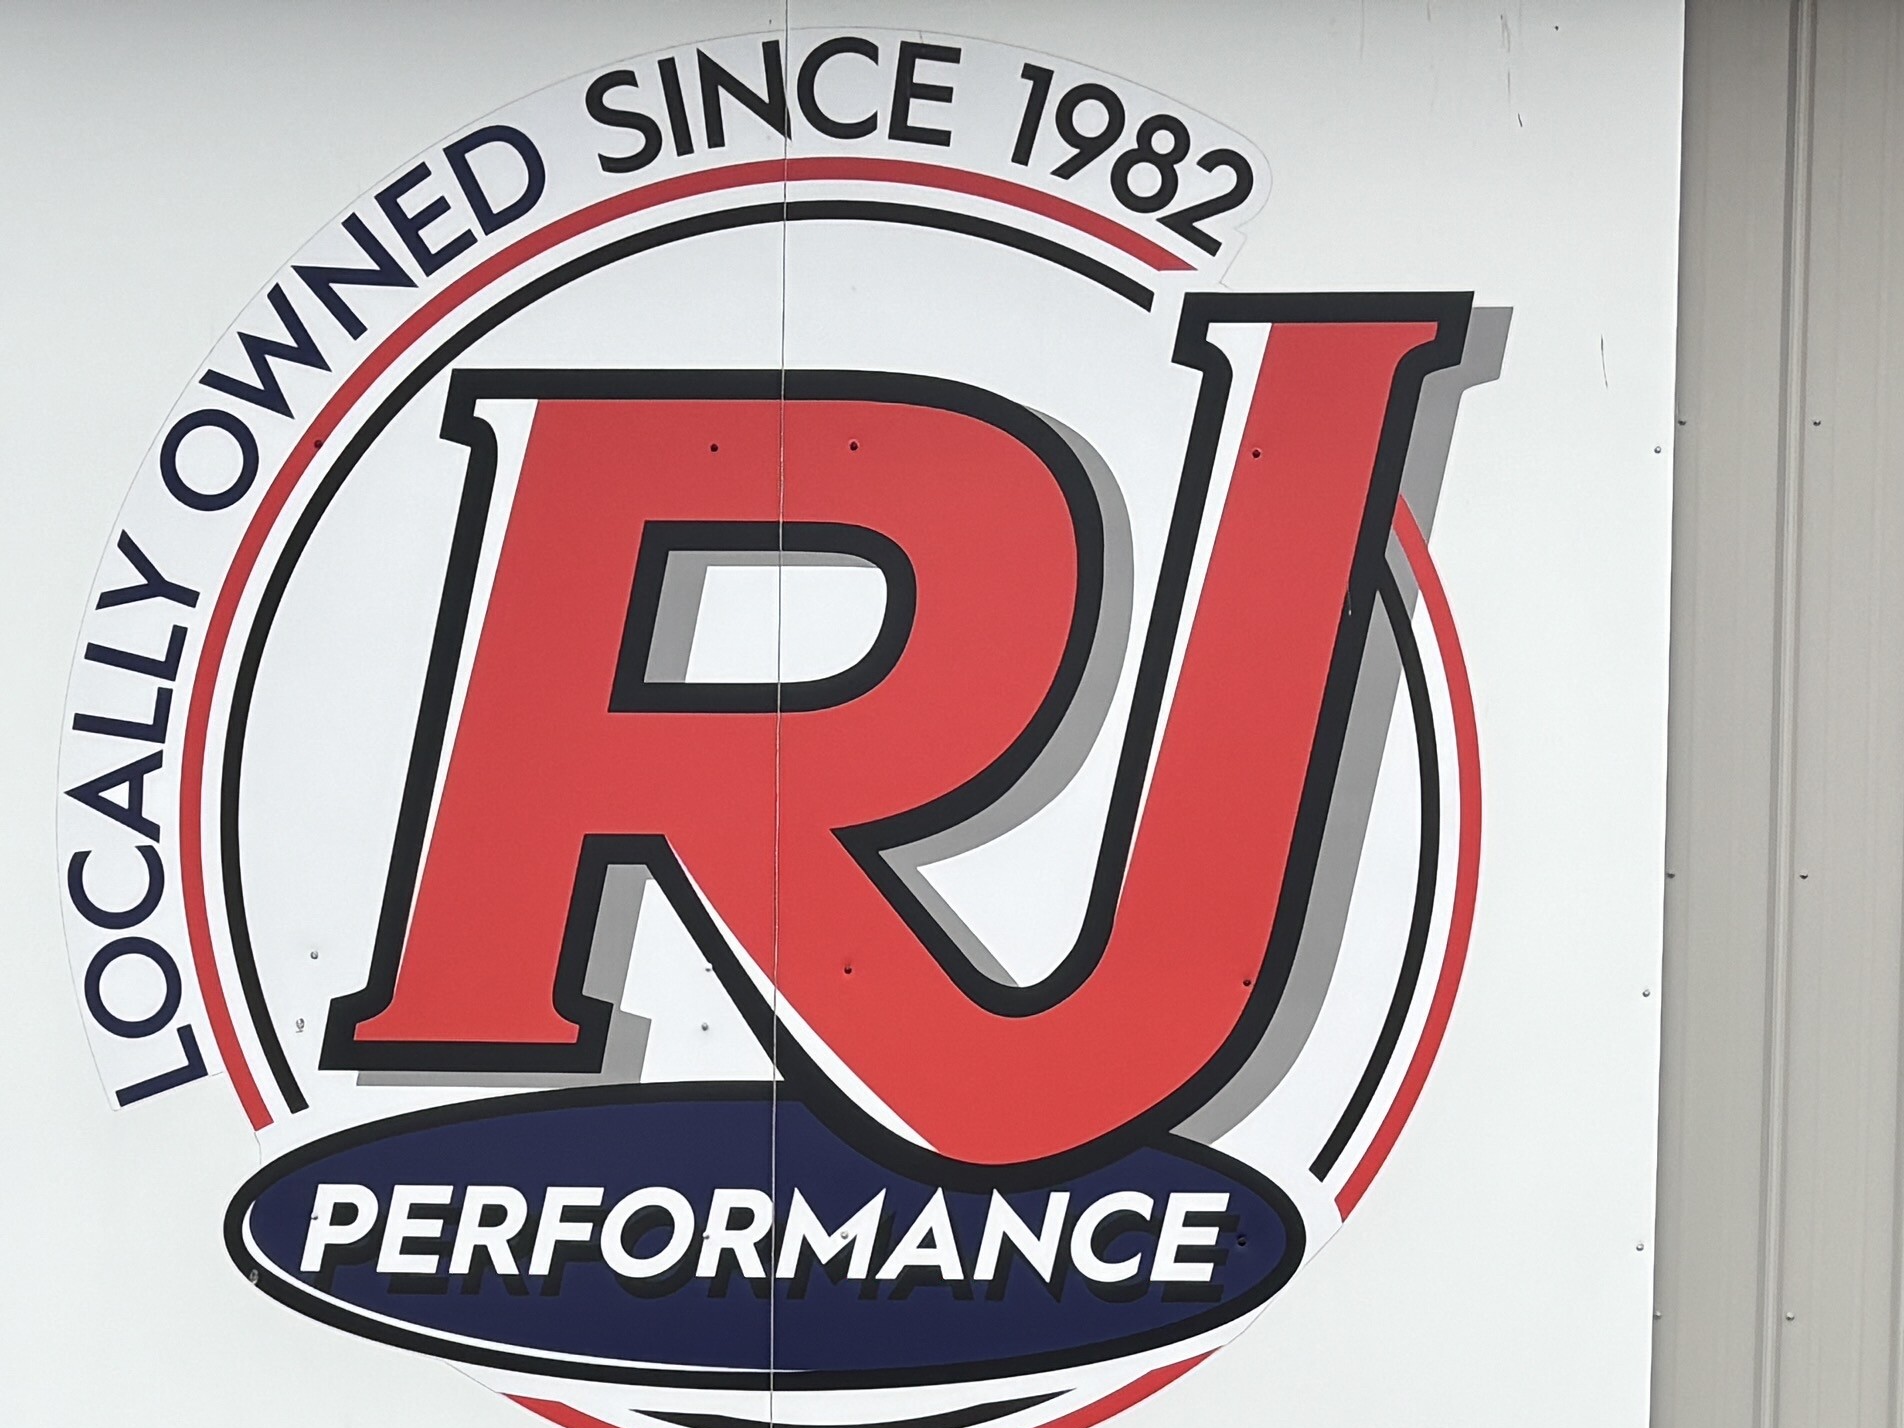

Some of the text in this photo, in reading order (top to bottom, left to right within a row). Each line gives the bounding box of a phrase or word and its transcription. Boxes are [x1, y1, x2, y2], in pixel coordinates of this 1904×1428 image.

[63, 36, 1254, 1107] LOCALLY OWNED SINCE 1982
[318, 289, 1474, 1187] RJ
[299, 1184, 1229, 1284] PERFORMANCE
